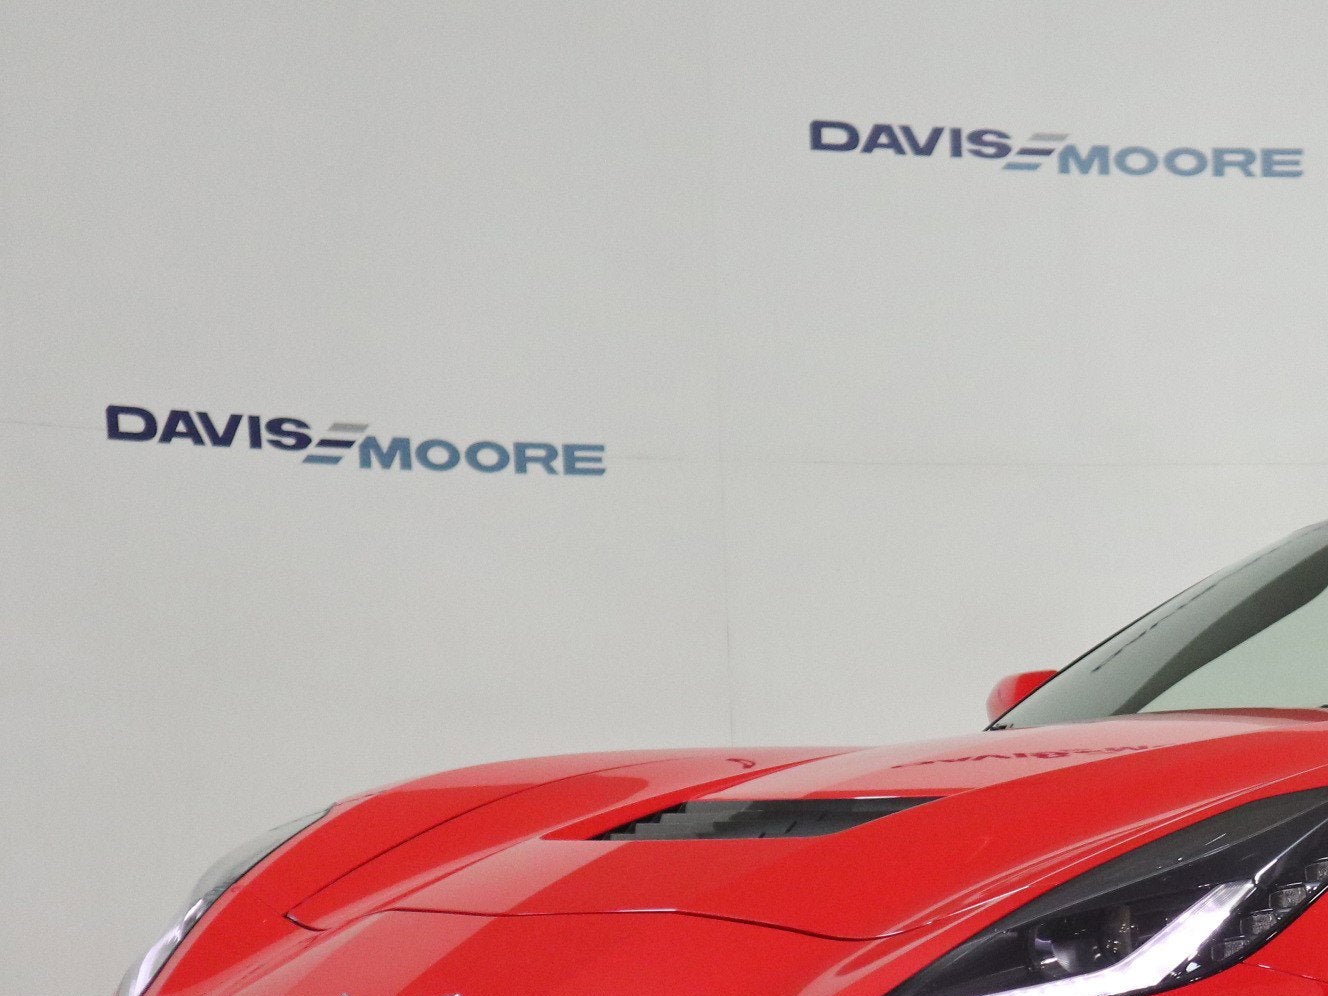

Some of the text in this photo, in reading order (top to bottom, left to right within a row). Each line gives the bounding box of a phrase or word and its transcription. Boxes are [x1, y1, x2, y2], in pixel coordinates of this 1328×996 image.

[808, 119, 1303, 178] DAVIS MOORE
[105, 404, 606, 477] DAVIS MOORE
